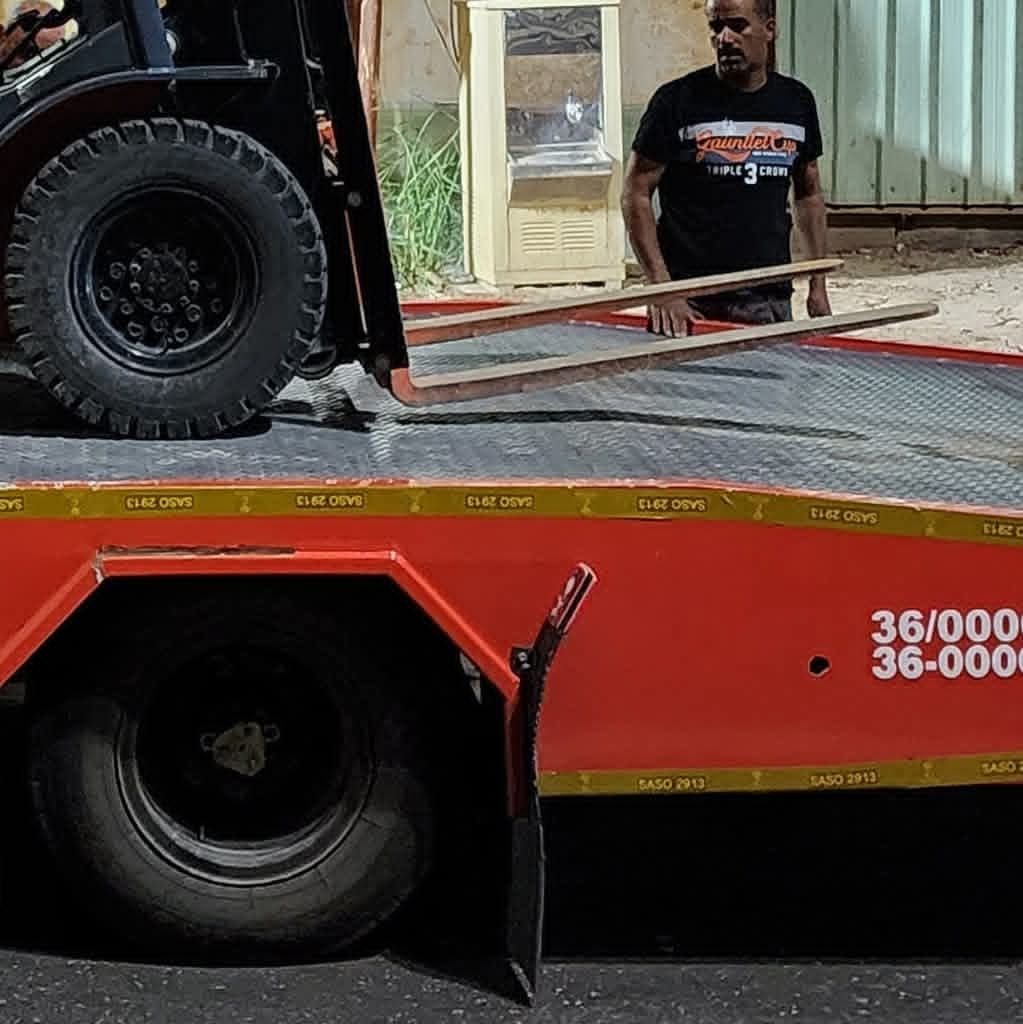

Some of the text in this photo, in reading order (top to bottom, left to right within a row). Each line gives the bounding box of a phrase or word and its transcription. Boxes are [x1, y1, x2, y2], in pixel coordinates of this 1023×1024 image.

[706, 165, 742, 176] TRIPLE
[744, 163, 758, 185] 3
[159, 496, 193, 507] SASO
[329, 495, 363, 507] SASO
[500, 495, 533, 507] SASO
[671, 498, 705, 510] SASO
[843, 510, 878, 524] SASO
[871, 608, 1023, 643] 36/000
[871, 644, 1023, 679] 36-000
[638, 777, 706, 791] SASO 2913
